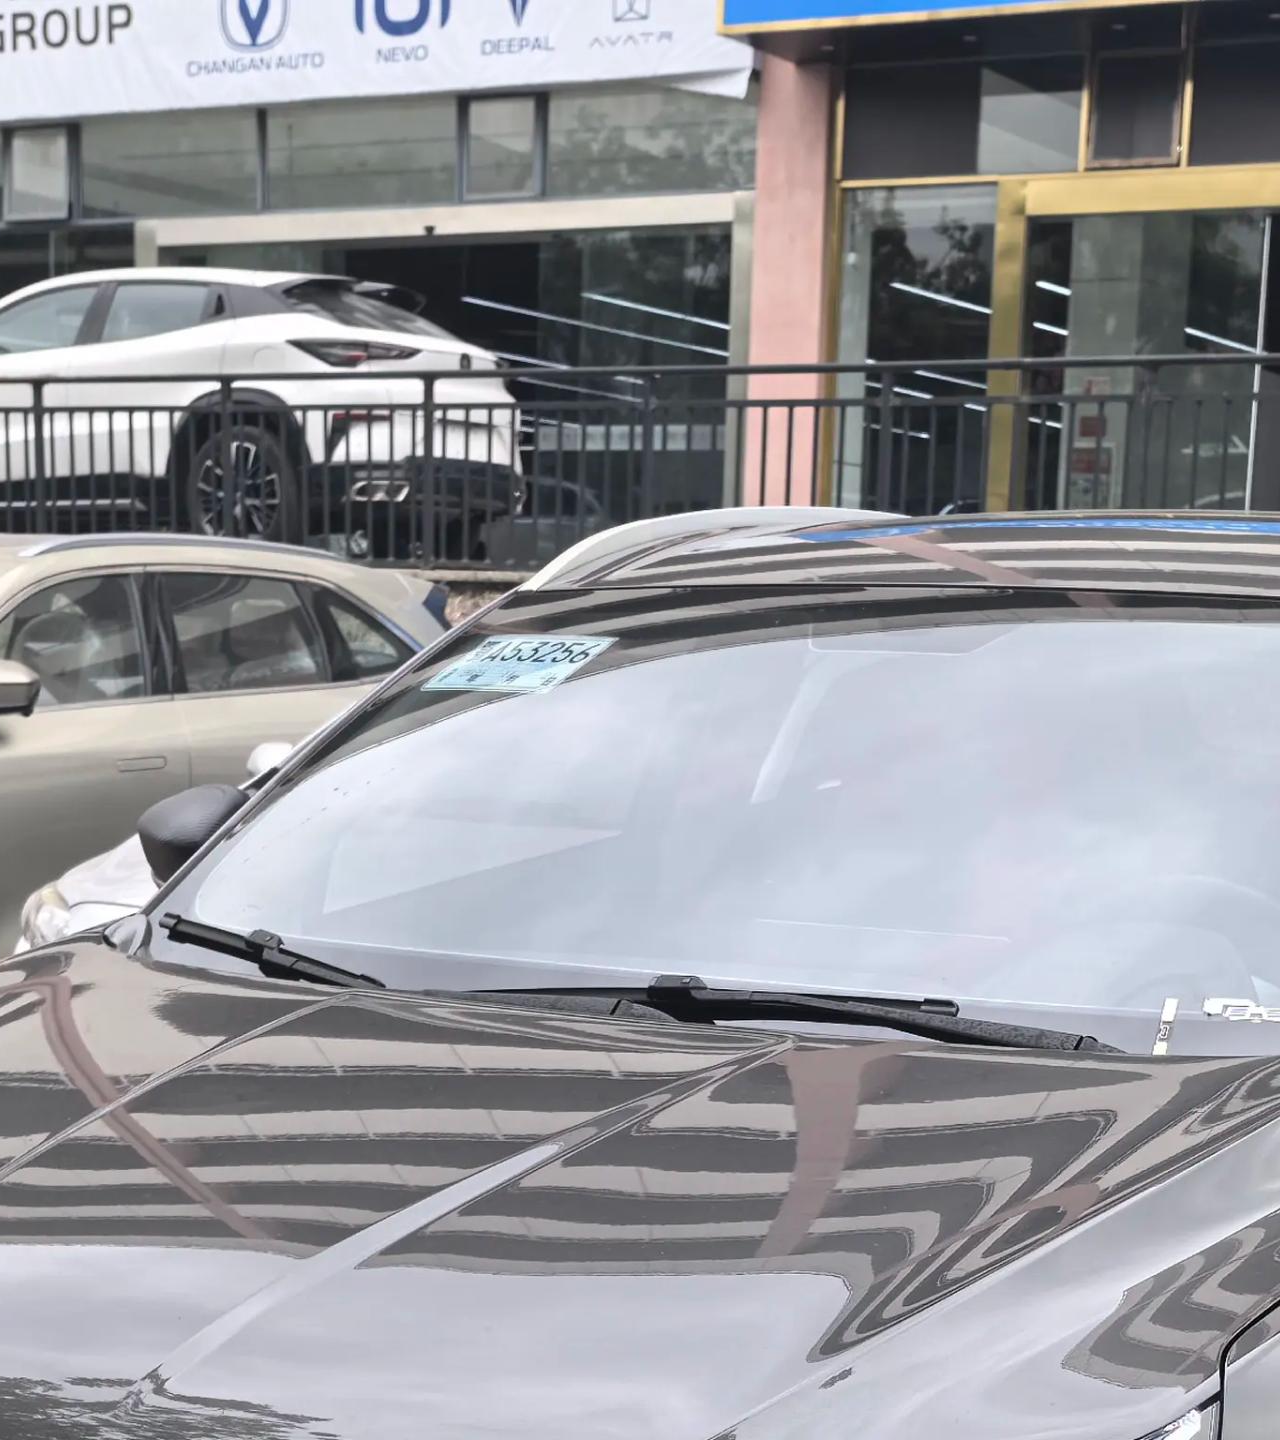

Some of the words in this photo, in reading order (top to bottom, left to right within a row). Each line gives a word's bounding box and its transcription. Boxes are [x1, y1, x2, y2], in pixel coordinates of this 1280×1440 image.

[375, 45, 429, 64] NEVO
[480, 36, 555, 56] DEEPAL
[186, 55, 271, 77] CHANGAN
[275, 52, 325, 70] AUTO
